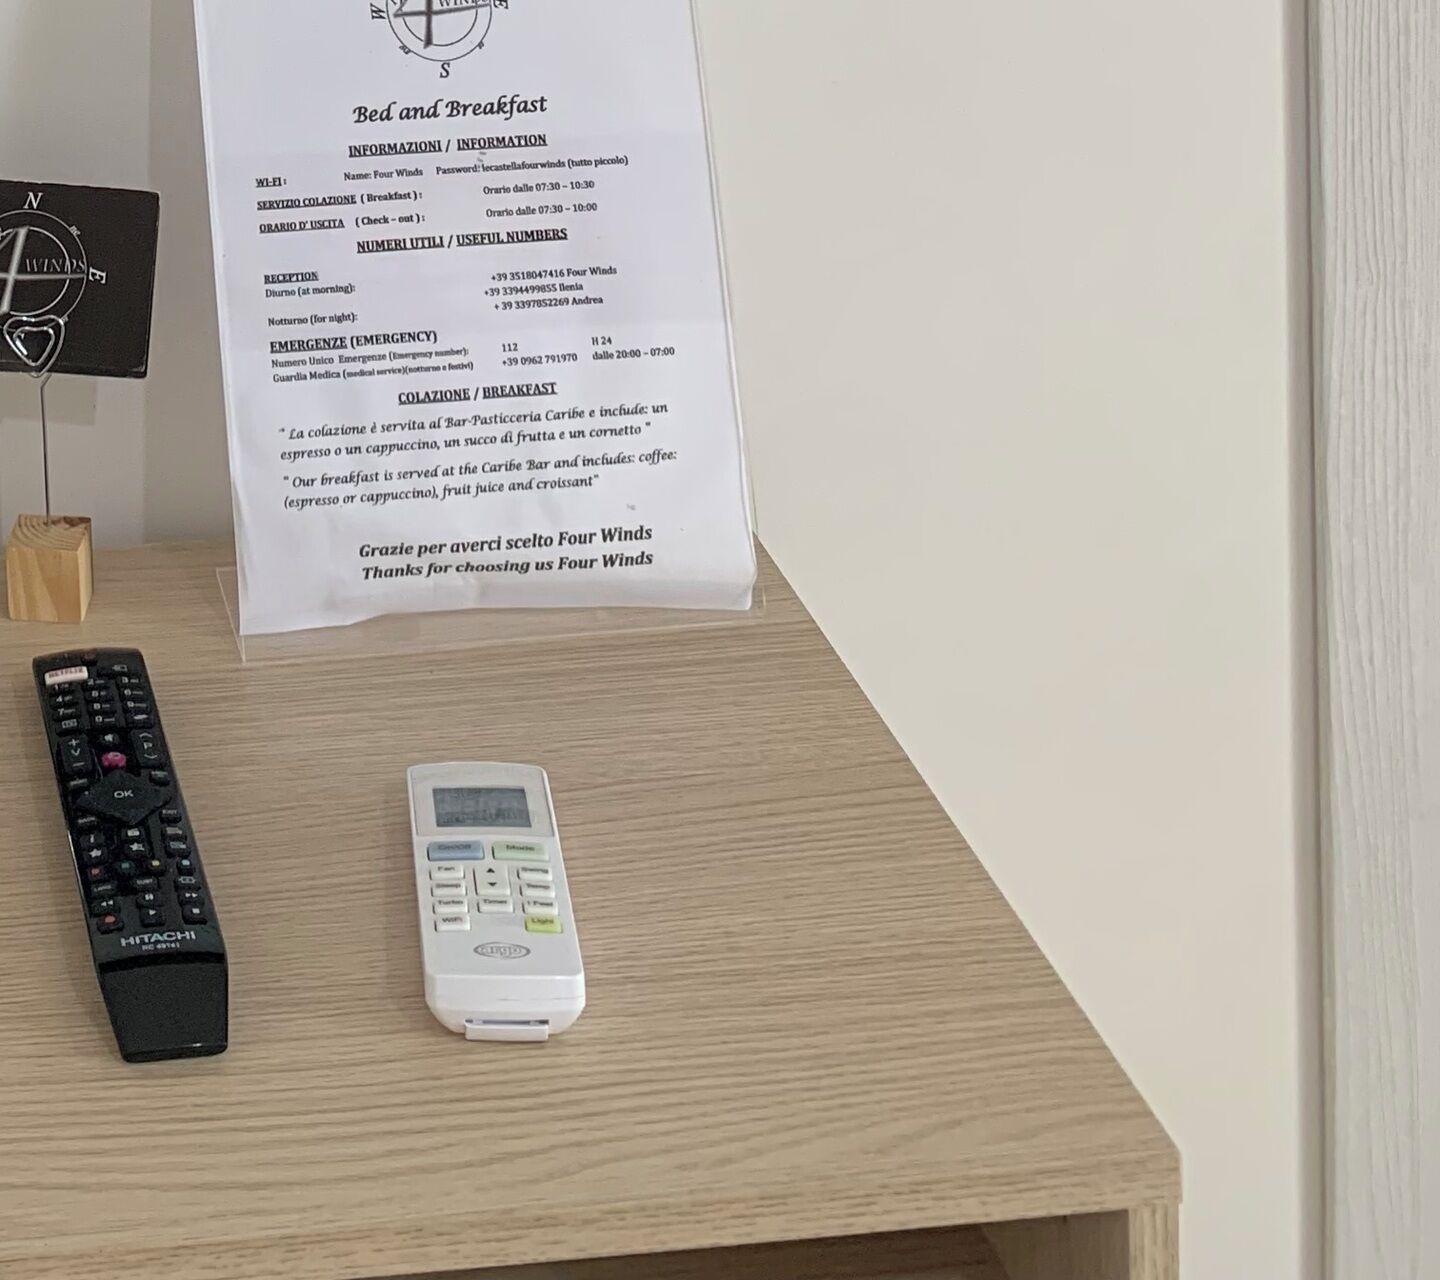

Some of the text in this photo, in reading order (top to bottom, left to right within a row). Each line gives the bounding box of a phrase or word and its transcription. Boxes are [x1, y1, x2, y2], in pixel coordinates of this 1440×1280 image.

[370, 3, 387, 20] W
[440, 62, 451, 78] S
[353, 94, 547, 125] Bed and Breakfast
[348, 134, 548, 158] INFORMAZIONI INFORMATION
[436, 164, 481, 175] Password:
[568, 158, 593, 170] (tutto
[594, 156, 629, 168] piccolo)
[344, 168, 423, 181] Name: Four Winds
[483, 180, 595, 195] Orario dalle 07:30 10:30
[23, 192, 43, 209] N
[257, 200, 301, 211] SERVIZIO
[302, 194, 357, 208] COLAZIONE
[486, 202, 597, 218] Orario dalle 07:30 10:00
[259, 223, 297, 233] ORARIO
[310, 218, 345, 229] USCITA
[357, 228, 568, 254] NUMERI UTILI USEFUL NUMBERS
[26, 258, 85, 273] WINDS
[88, 266, 107, 285] E
[264, 272, 319, 284] RECEPTION
[492, 266, 617, 282] +39 3518047416 Four Winds
[265, 283, 355, 298] Diurno (at morning):
[484, 287, 500, 298] +39
[572, 296, 603, 306] Andrea
[268, 312, 358, 327] Notturno (for night):
[270, 330, 438, 354] EMERGENZE (EMERGENCY)
[502, 342, 518, 353] 112
[601, 336, 612, 346] 24
[272, 357, 307, 368] Numero
[309, 356, 334, 366] Unico
[338, 352, 387, 365] Emergenze
[502, 352, 578, 367] +39 0962 791970
[592, 346, 675, 361] dalle 20:00 07:00
[274, 372, 307, 383] Guardia
[310, 370, 341, 381] Medica
[398, 382, 558, 406] COLAZIONE BREAKFAST
[308, 403, 669, 439] colazione è servita al Bar-Pasticceria Caribe e include: un
[280, 424, 642, 463] espresso o un cappuccino, un succo di frutta e un cornetto
[321, 472, 379, 488] breakfast
[384, 470, 393, 481] is
[397, 465, 441, 481] served
[442, 465, 455, 477] at
[458, 462, 478, 475] the
[482, 458, 522, 474] Caribe
[526, 458, 551, 471] Bar
[554, 454, 581, 469] and
[582, 452, 635, 468] includes:
[639, 448, 678, 466] coffee:
[284, 494, 339, 511] (espresso
[343, 492, 356, 504] or
[360, 486, 438, 505] cappuccino),
[442, 484, 472, 501] fruit
[474, 479, 504, 497] juice
[508, 476, 537, 492] and
[360, 524, 652, 558] Grazie per averci scelto Four Winds
[362, 550, 653, 581] Thanks for choosing us Four Winds
[114, 790, 134, 799] OK
[120, 931, 196, 947] HITACHI
